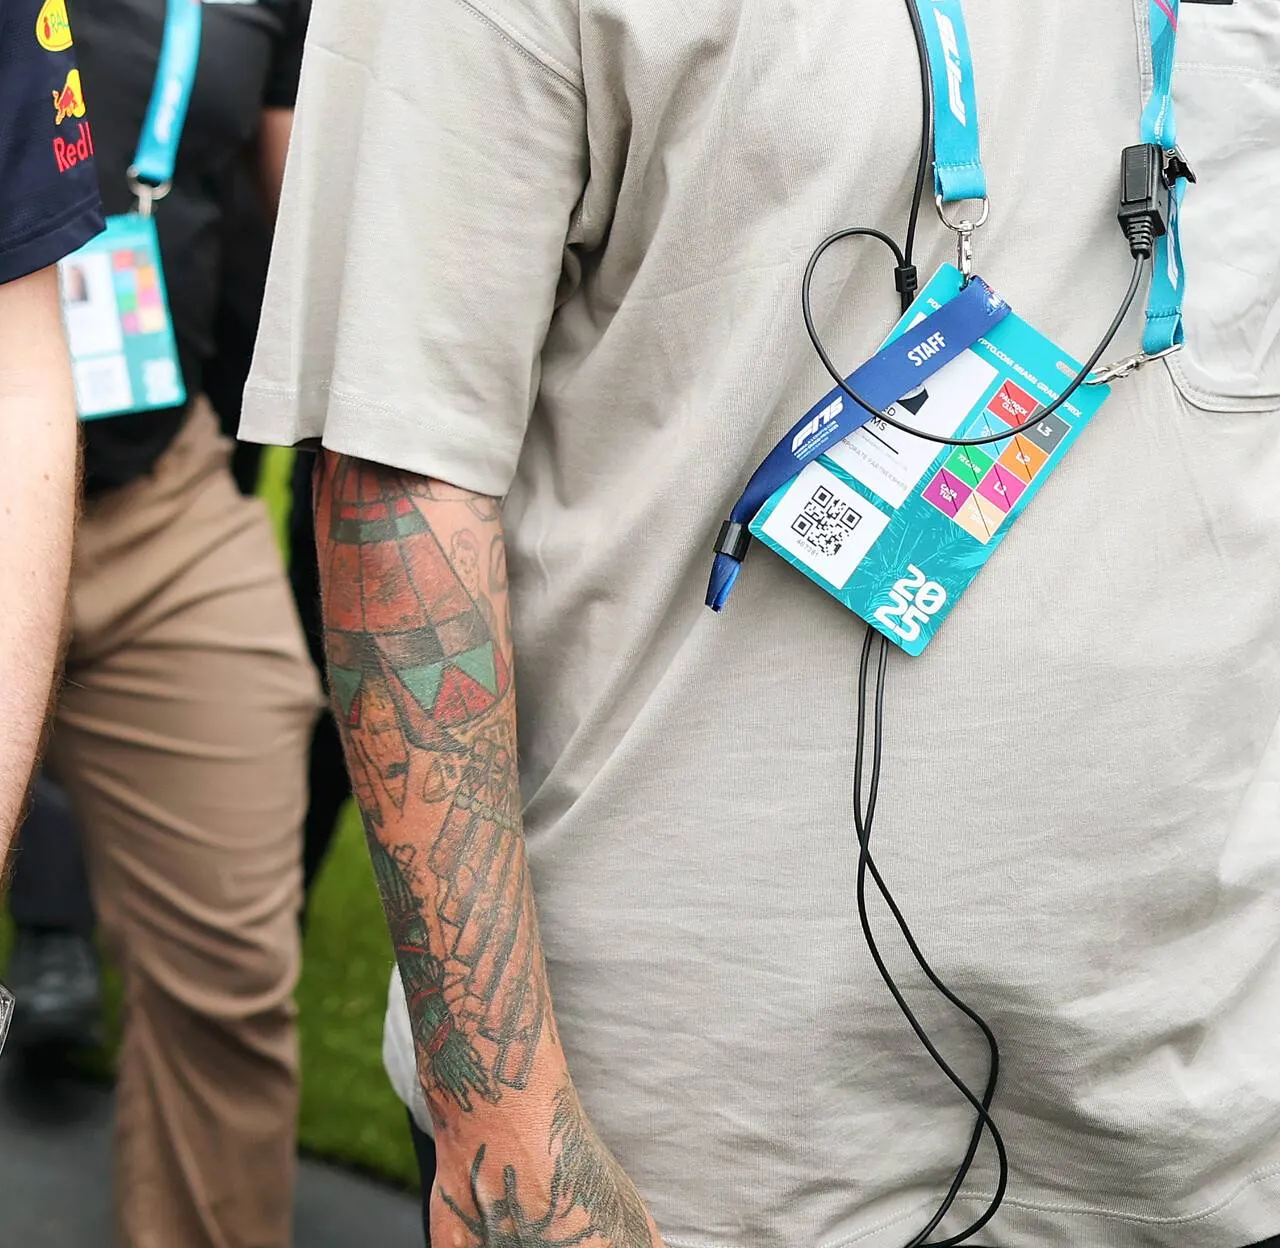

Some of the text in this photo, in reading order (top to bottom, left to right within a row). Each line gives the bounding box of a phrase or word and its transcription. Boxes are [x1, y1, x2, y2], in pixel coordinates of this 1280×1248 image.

[907, 331, 947, 367] STAFF
[1036, 381, 1060, 401] GRAN
[1037, 422, 1054, 438] L3
